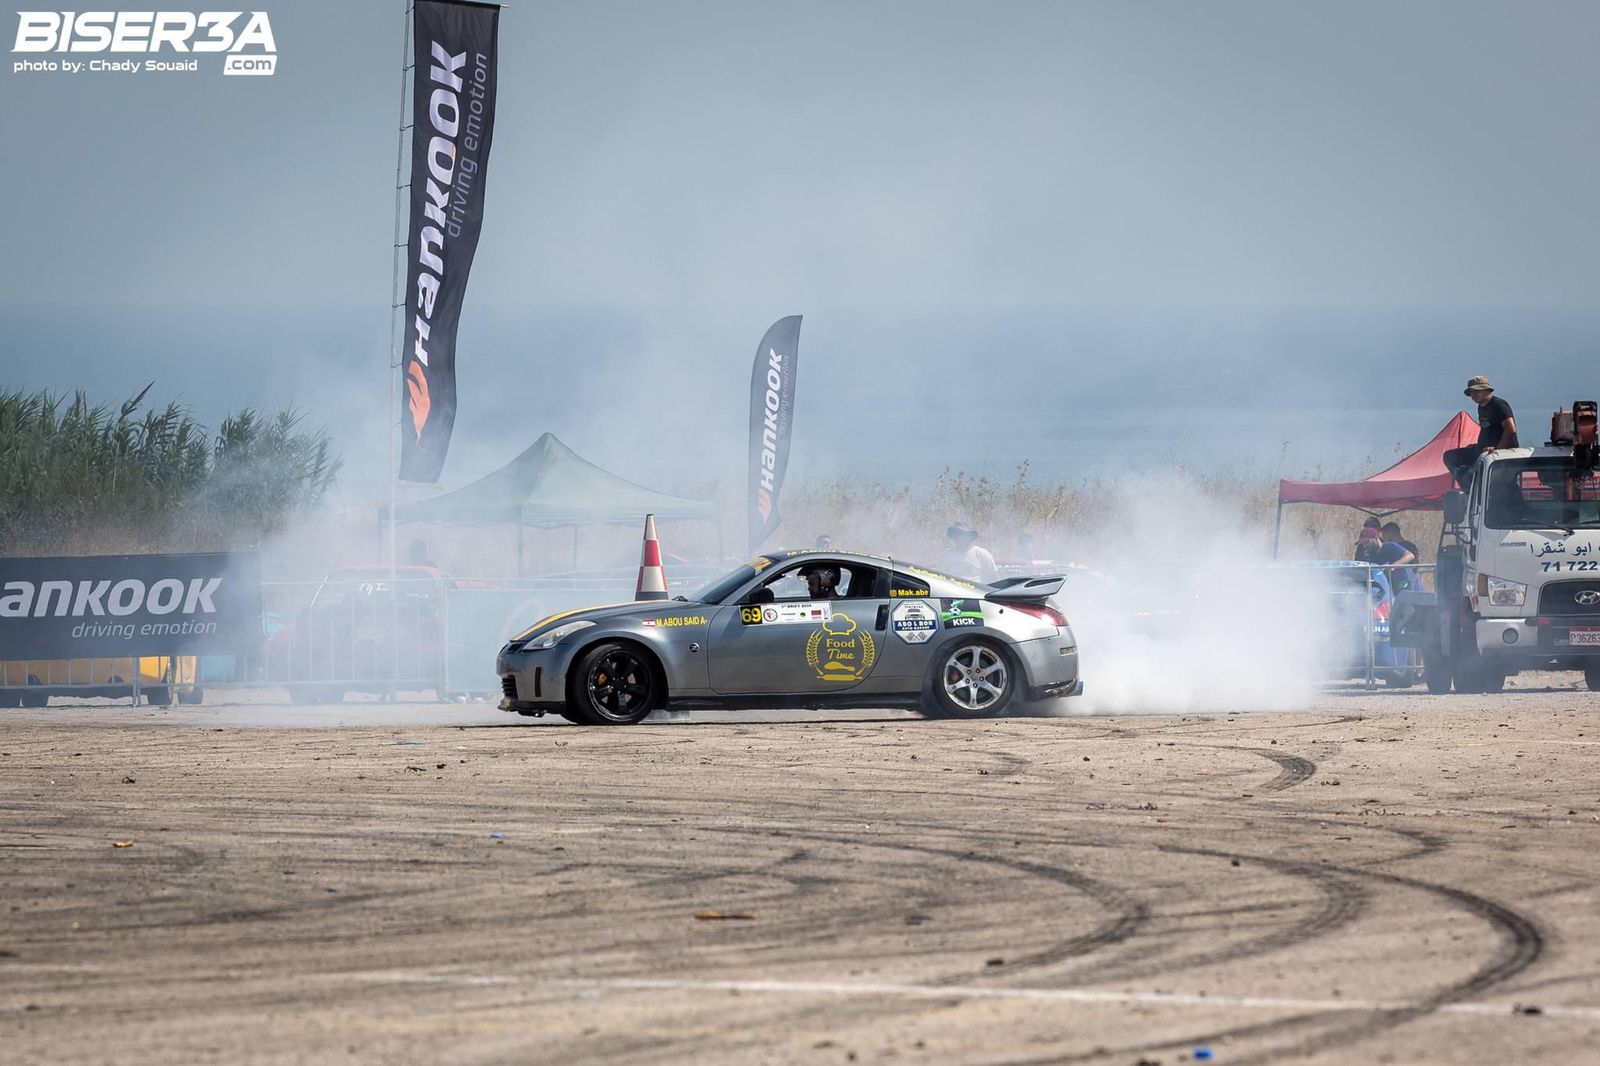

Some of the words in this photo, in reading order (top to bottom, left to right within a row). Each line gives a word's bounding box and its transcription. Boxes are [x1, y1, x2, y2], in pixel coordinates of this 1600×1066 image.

[447, 157, 478, 238] driving
[464, 52, 487, 151] emotion
[1541, 561, 1561, 572] 71
[1567, 560, 1598, 571] 722
[684, 616, 700, 625] SAID
[742, 606, 762, 623] 69
[952, 618, 976, 626] KICK
[72, 621, 135, 640] driving
[140, 619, 217, 635] emotion
[826, 638, 855, 648] Food
[827, 648, 856, 660] Time
